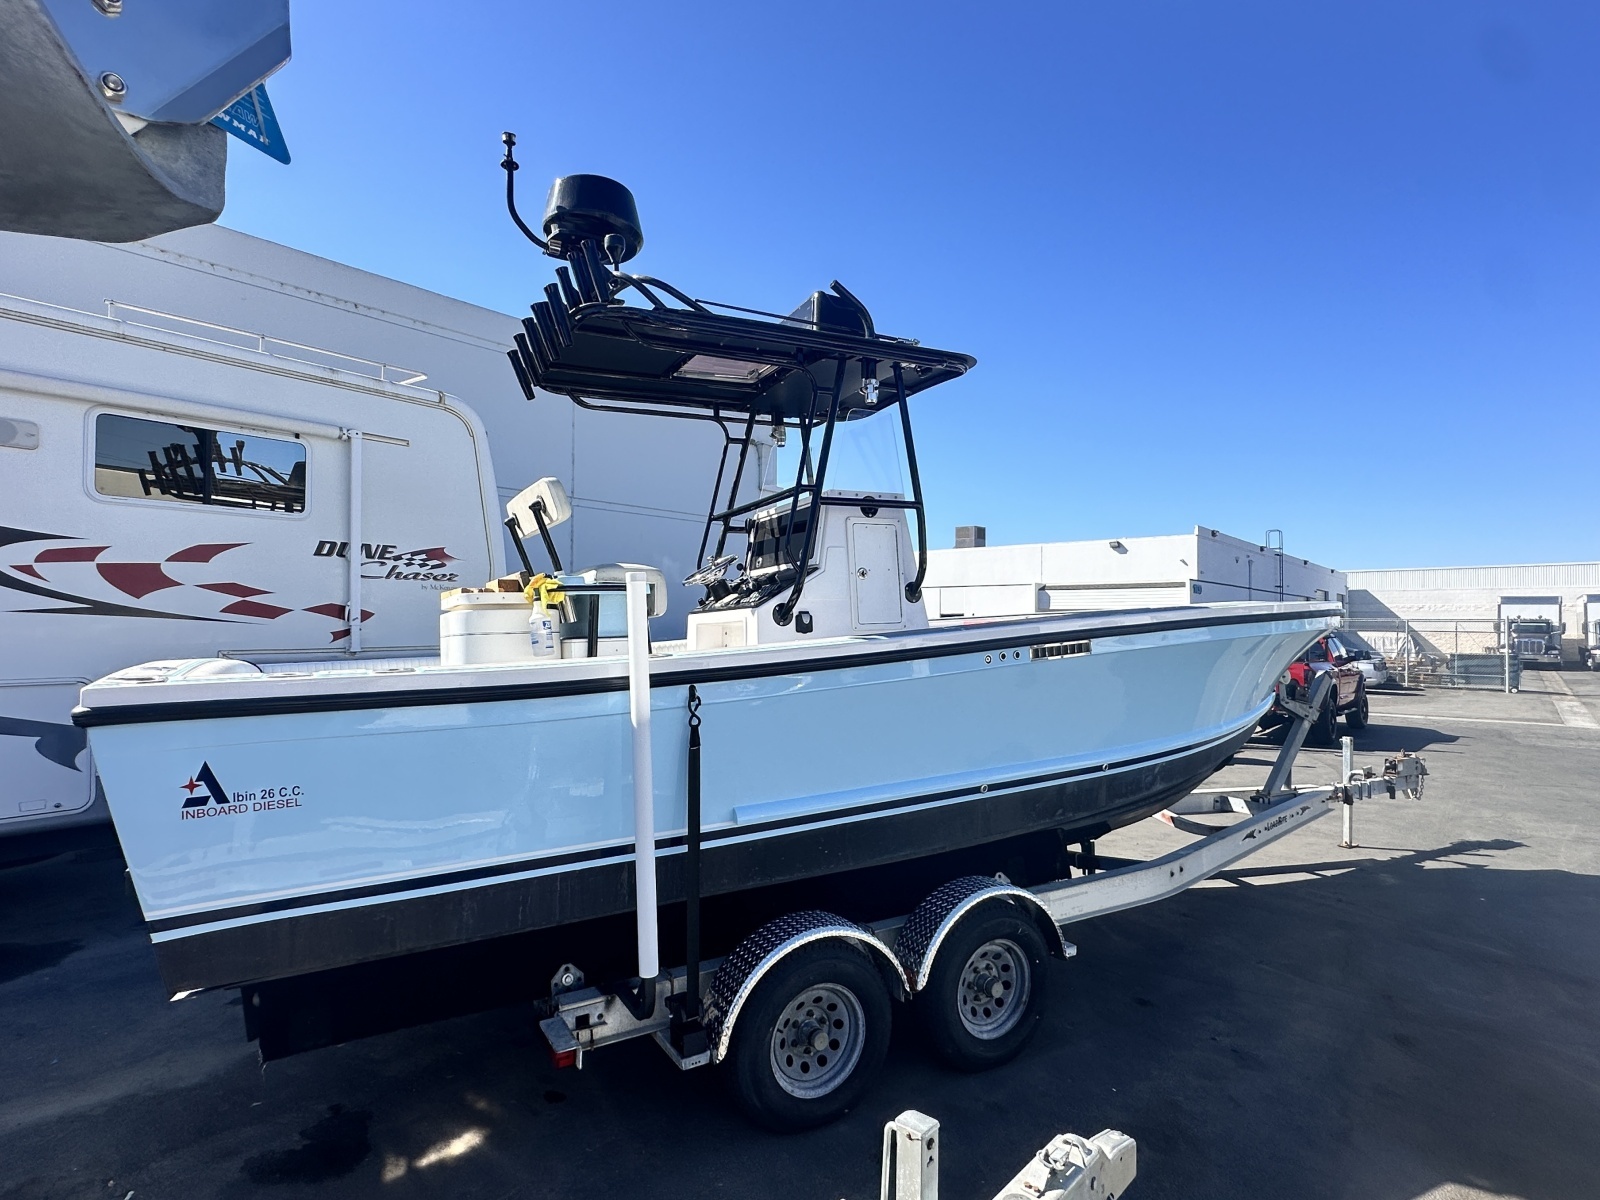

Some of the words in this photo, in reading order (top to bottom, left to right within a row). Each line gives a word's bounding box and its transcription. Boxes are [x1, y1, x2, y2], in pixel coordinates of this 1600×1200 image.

[360, 560, 459, 582] Chaser
[260, 788, 275, 800] 26
[278, 785, 305, 798] C.C.
[181, 803, 248, 820] INBOARD
[252, 798, 302, 812] DIESEL
